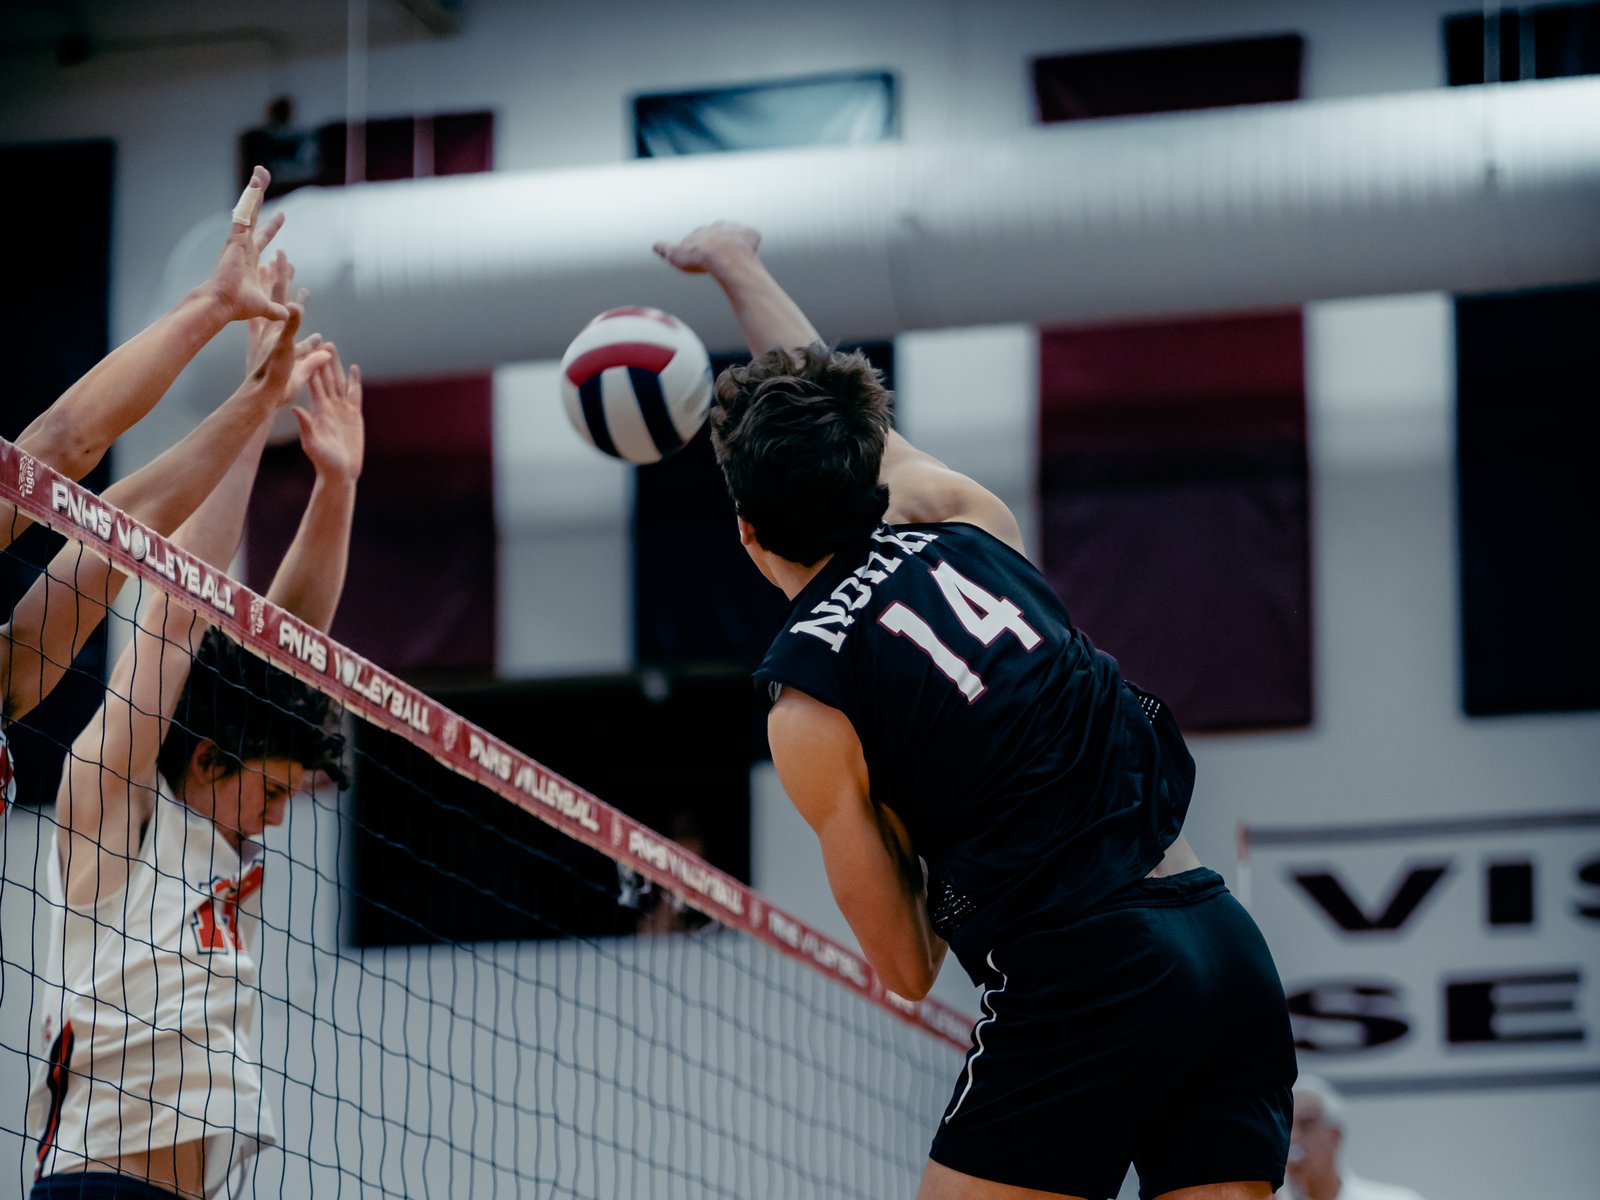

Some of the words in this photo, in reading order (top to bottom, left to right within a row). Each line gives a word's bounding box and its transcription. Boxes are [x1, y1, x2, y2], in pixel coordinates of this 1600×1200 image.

[52, 480, 113, 541] PNHS
[117, 518, 235, 617] VOLLEYBALL
[279, 620, 328, 673] PNHS
[877, 560, 1043, 704] 14
[1290, 855, 1600, 934] VI
